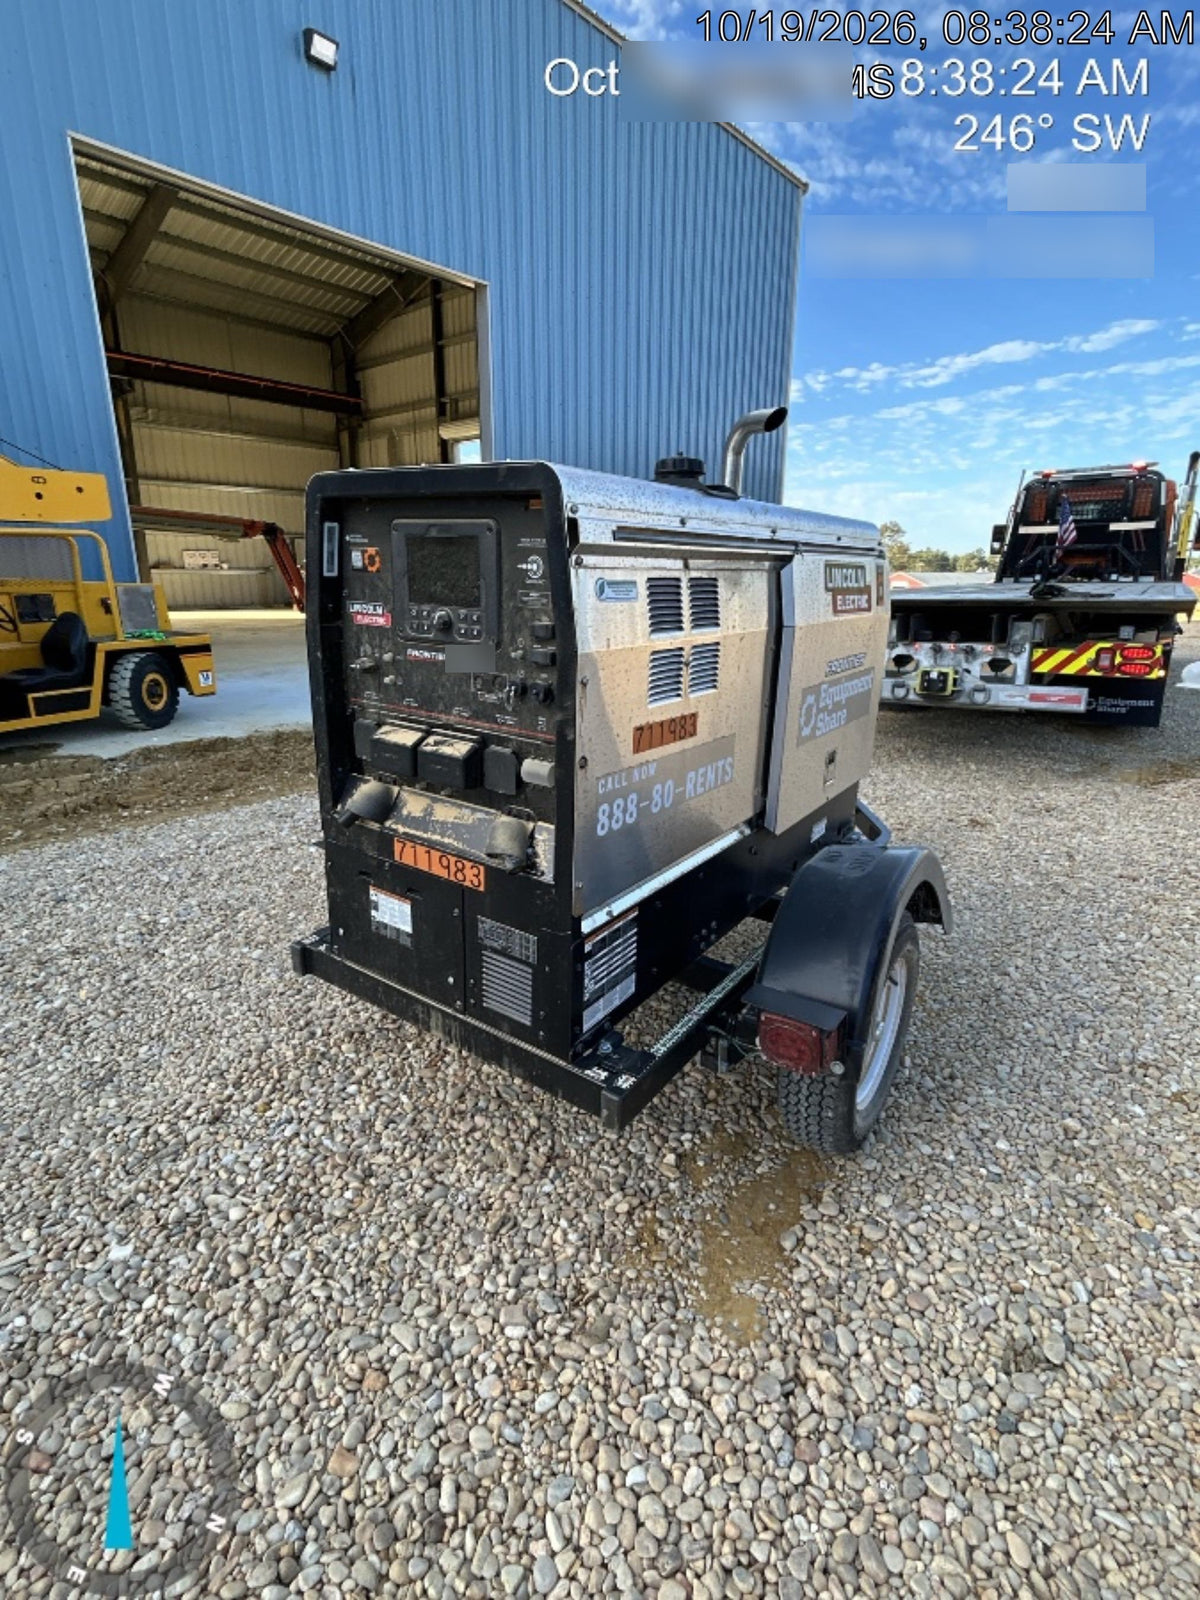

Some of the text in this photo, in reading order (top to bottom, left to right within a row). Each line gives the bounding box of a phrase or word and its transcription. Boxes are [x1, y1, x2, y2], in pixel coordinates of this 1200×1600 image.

[826, 567, 867, 588] LINCOLN
[819, 671, 874, 710] Equipment
[635, 714, 698, 752] 711983
[816, 709, 848, 737] Share
[596, 757, 734, 837] 888-80-RENTS
[598, 762, 658, 794] CALL NOW
[396, 840, 482, 888] 711983
